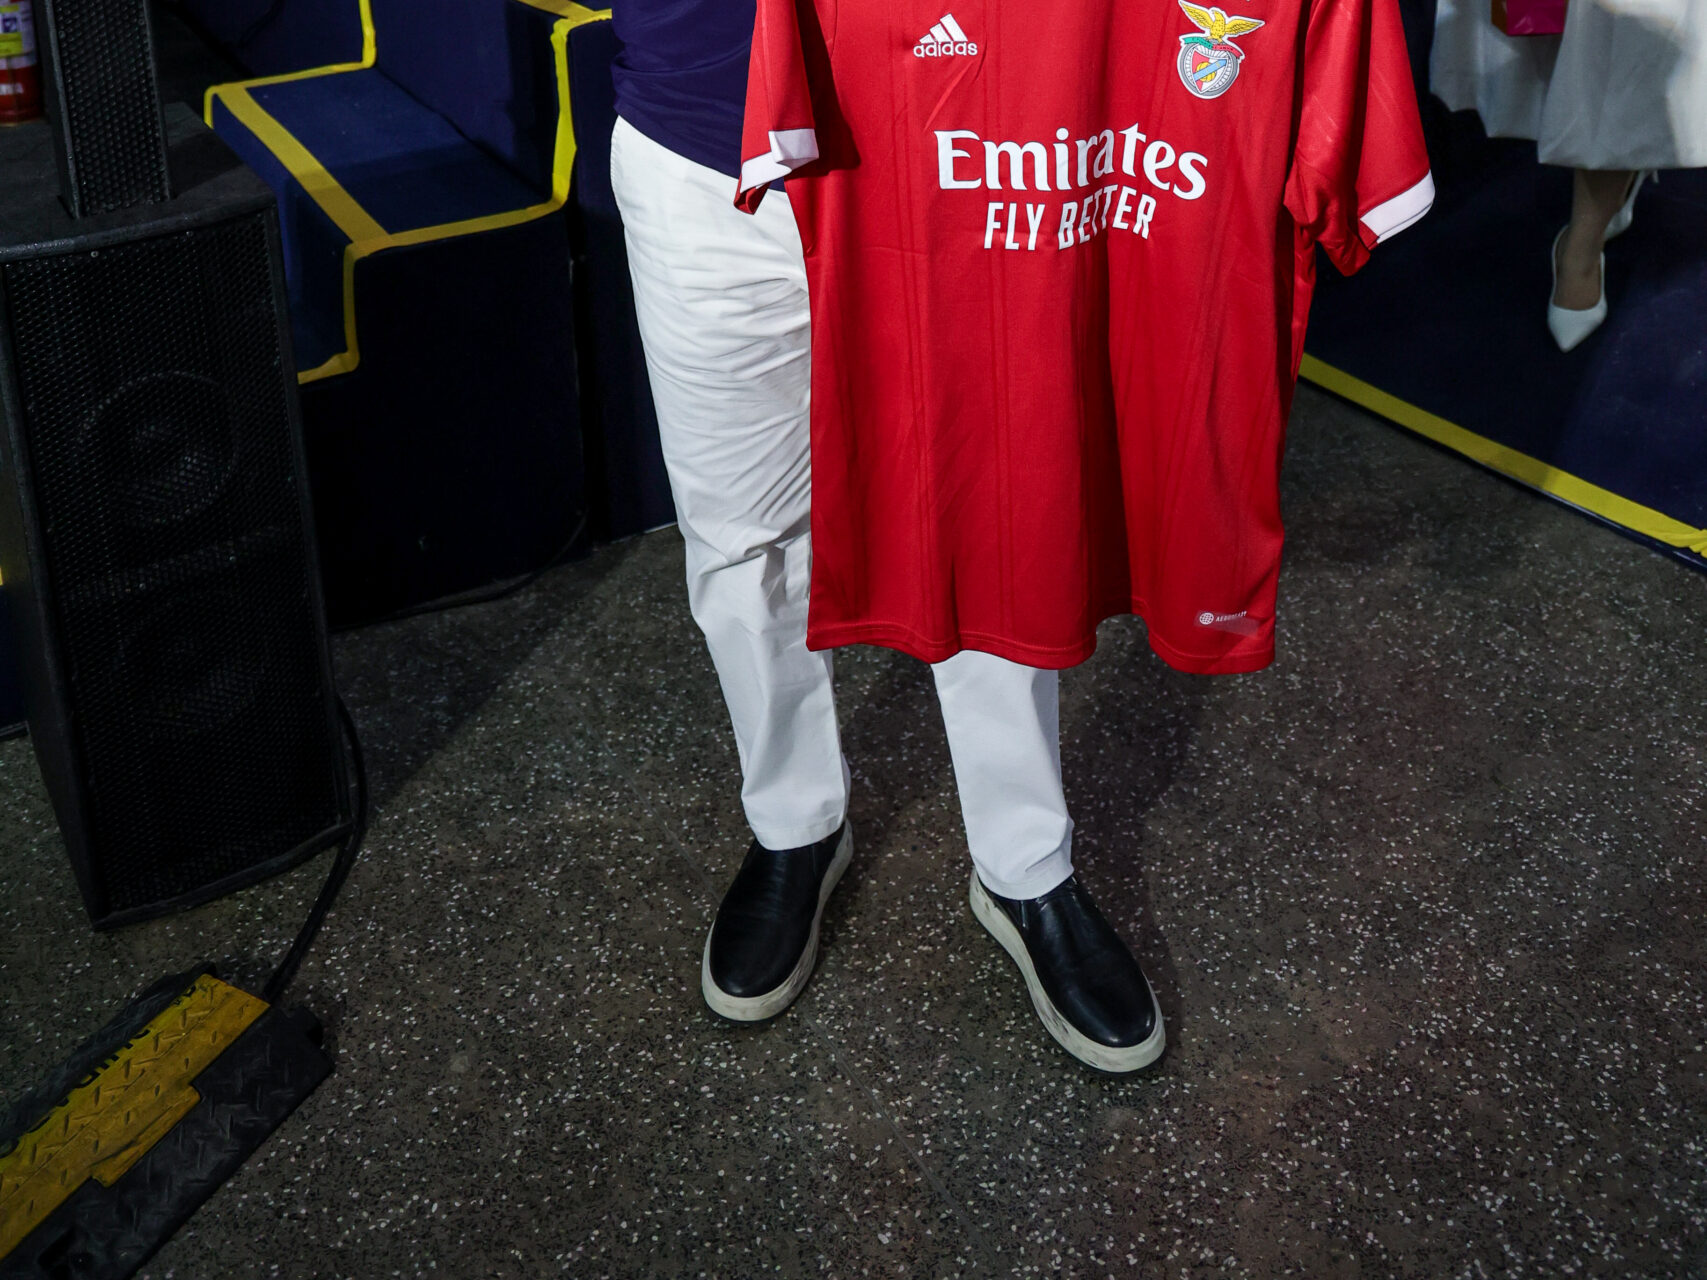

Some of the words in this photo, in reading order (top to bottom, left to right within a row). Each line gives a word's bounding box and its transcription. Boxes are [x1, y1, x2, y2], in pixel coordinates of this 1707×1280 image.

[913, 40, 978, 58] adidas
[934, 122, 1208, 200] Emirates
[983, 202, 1045, 250] FLY
[1057, 184, 1157, 251] BETTER
